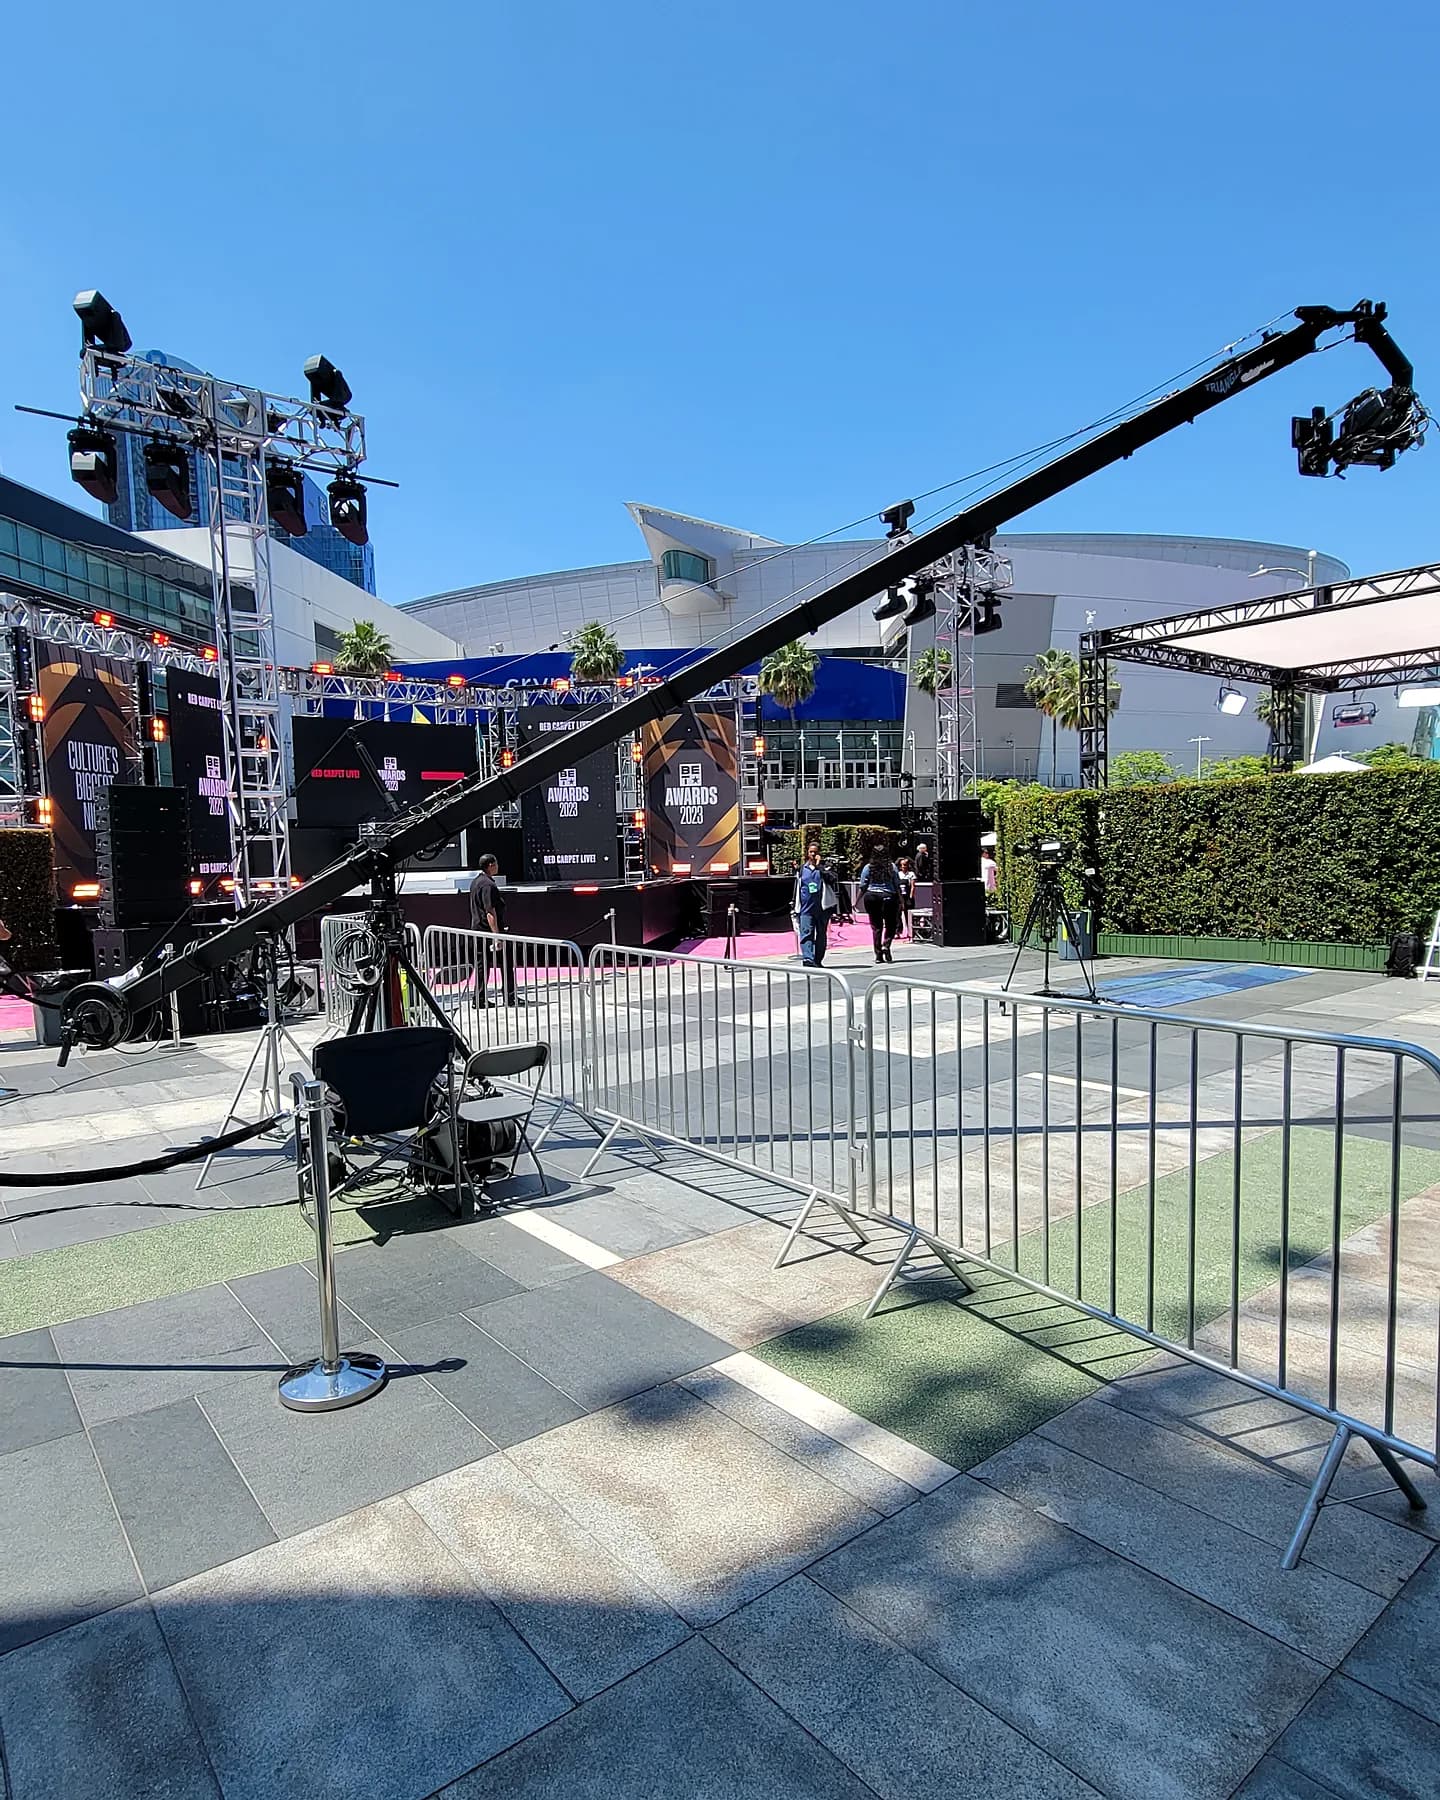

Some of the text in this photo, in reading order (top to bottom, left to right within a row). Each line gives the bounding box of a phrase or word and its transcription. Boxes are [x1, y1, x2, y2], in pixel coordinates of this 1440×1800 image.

[547, 786, 590, 803] AWARDS
[665, 786, 718, 806] AWARDS
[208, 797, 224, 816] 2023
[559, 801, 578, 818] 2023
[680, 805, 704, 825] 2023
[543, 855, 556, 864] RED
[556, 854, 580, 864] CARPET
